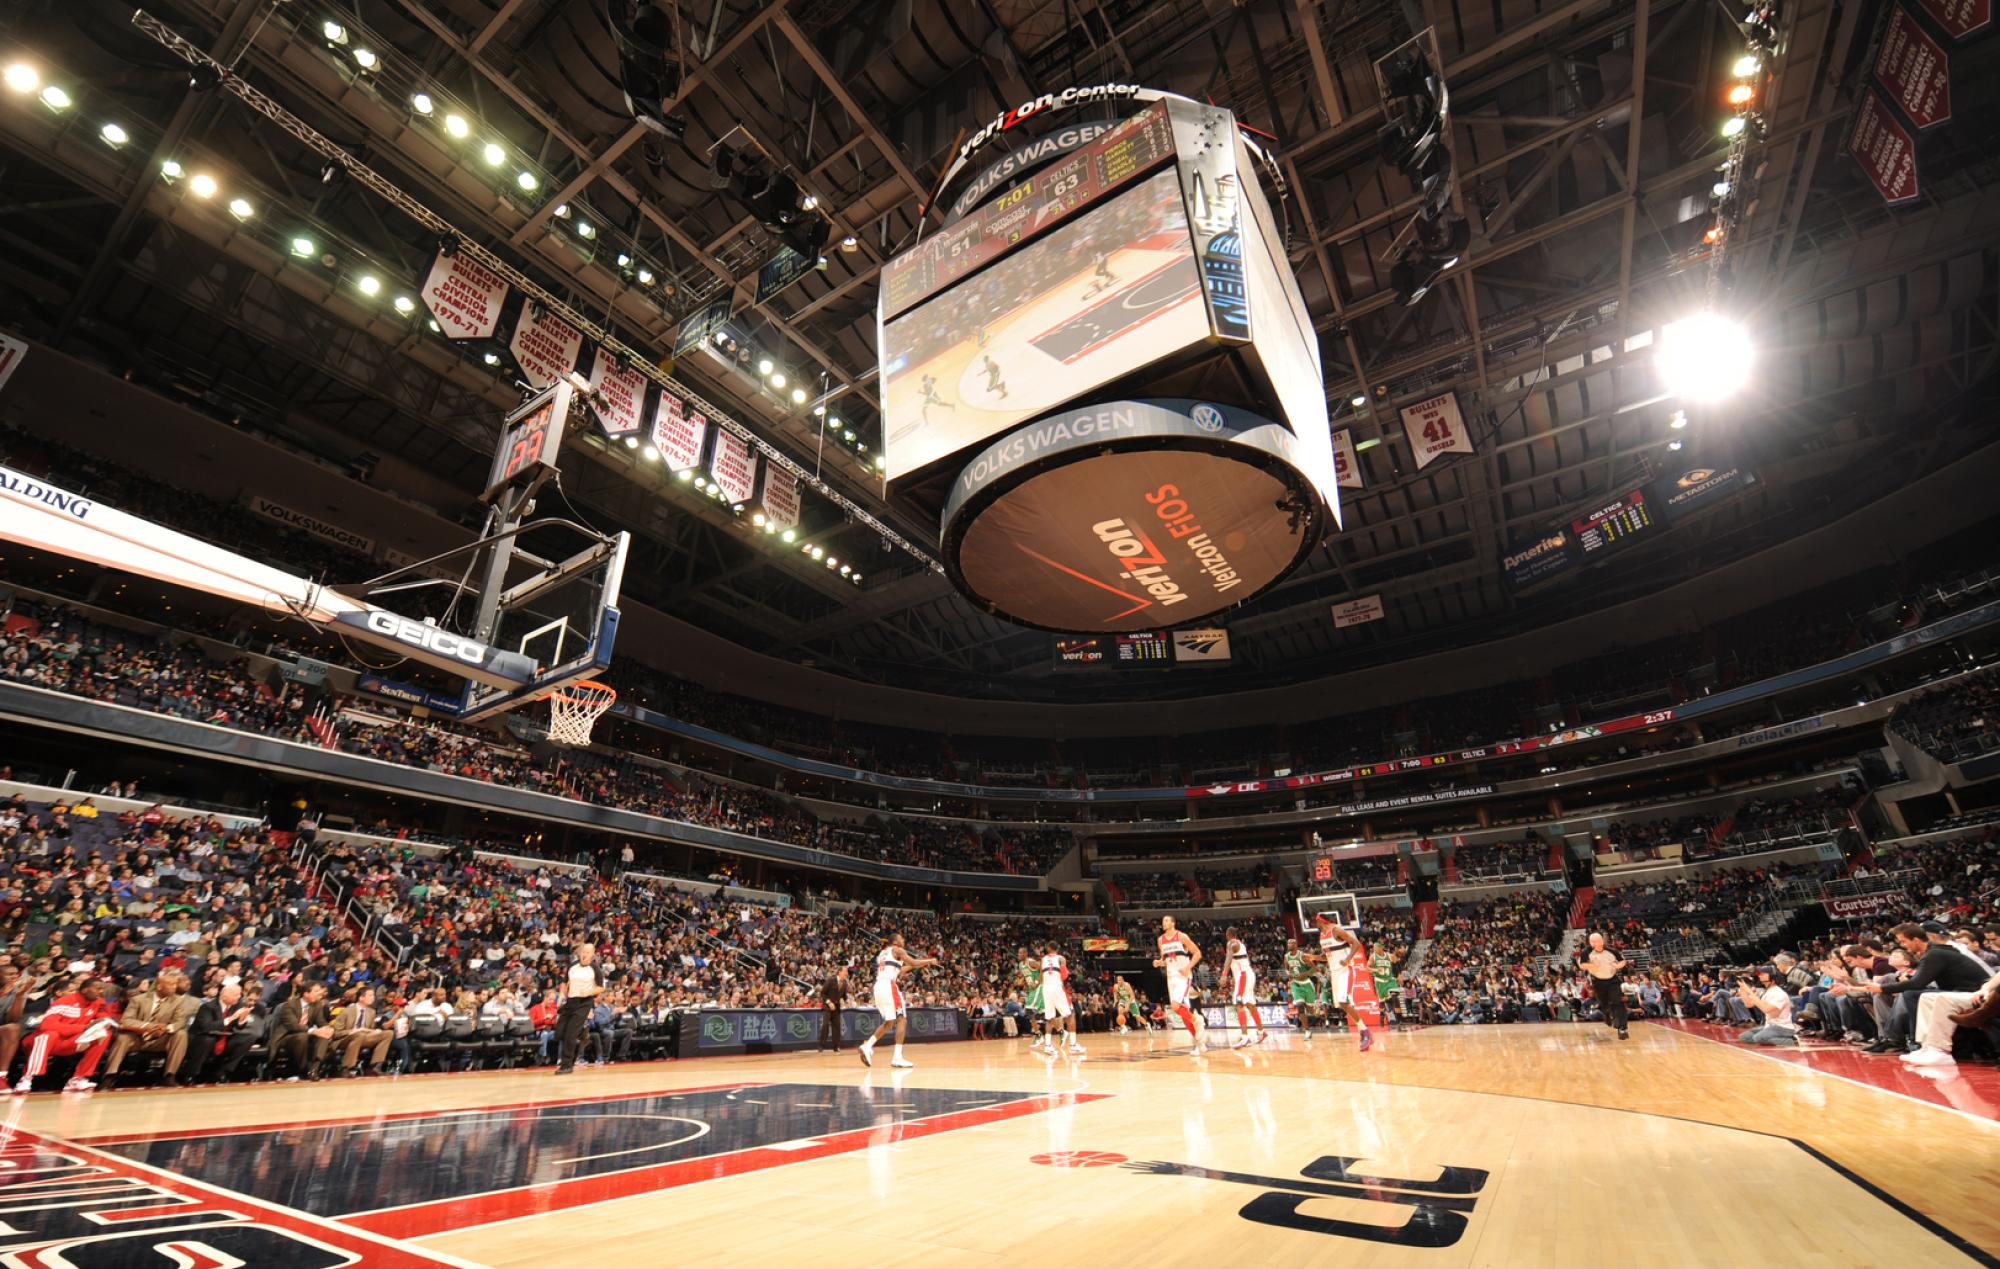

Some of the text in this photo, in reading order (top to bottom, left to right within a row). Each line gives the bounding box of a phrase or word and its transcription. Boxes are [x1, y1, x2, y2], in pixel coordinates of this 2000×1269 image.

[960, 82, 1139, 158] verizon Center
[997, 183, 1032, 211] 7:01
[1054, 174, 1078, 196] 63
[952, 238, 971, 257] 51
[452, 253, 504, 290] ALTIMORE
[452, 262, 493, 293] BULLETS
[442, 282, 487, 314] DIVISION
[448, 275, 488, 305] CENTRAL
[432, 287, 489, 326] CHAMPIONS
[433, 302, 479, 336] 1970-71
[530, 328, 565, 355] EASTERN
[540, 321, 569, 344] ULLETS
[519, 330, 570, 368] CONFERENCE
[600, 383, 633, 408] DIVISION
[603, 376, 633, 400] CENTRAL
[669, 406, 696, 428] BULTS
[1409, 396, 1448, 416] BULLETS
[1422, 411, 1439, 421] WES
[658, 420, 698, 450] CONFERENCE
[658, 429, 696, 456] CHAMPIONS
[1422, 416, 1452, 443] 41
[660, 442, 691, 466] 1974-75
[963, 407, 1135, 491] VOLKSWAGEN
[1426, 439, 1456, 454] UNSELD
[1335, 450, 1348, 474] 5
[1144, 483, 1201, 539] FiOS
[1590, 501, 1622, 521] CELTICS
[258, 500, 368, 552] VOLKSWAGEN
[1092, 517, 1188, 607] verizon
[367, 609, 488, 665] GEICO
[307, 663, 327, 675] 200
[1062, 650, 1102, 663] verizon
[1644, 711, 1673, 725] 2:37
[1342, 804, 1356, 813] FULL
[1357, 802, 1374, 811] LEASE
[1375, 800, 1389, 809] AND
[1390, 797, 1409, 807] EVENT
[1434, 790, 1458, 801] SUITES
[1458, 785, 1492, 797] AVAILABLE
[1833, 896, 1886, 912] Courtside
